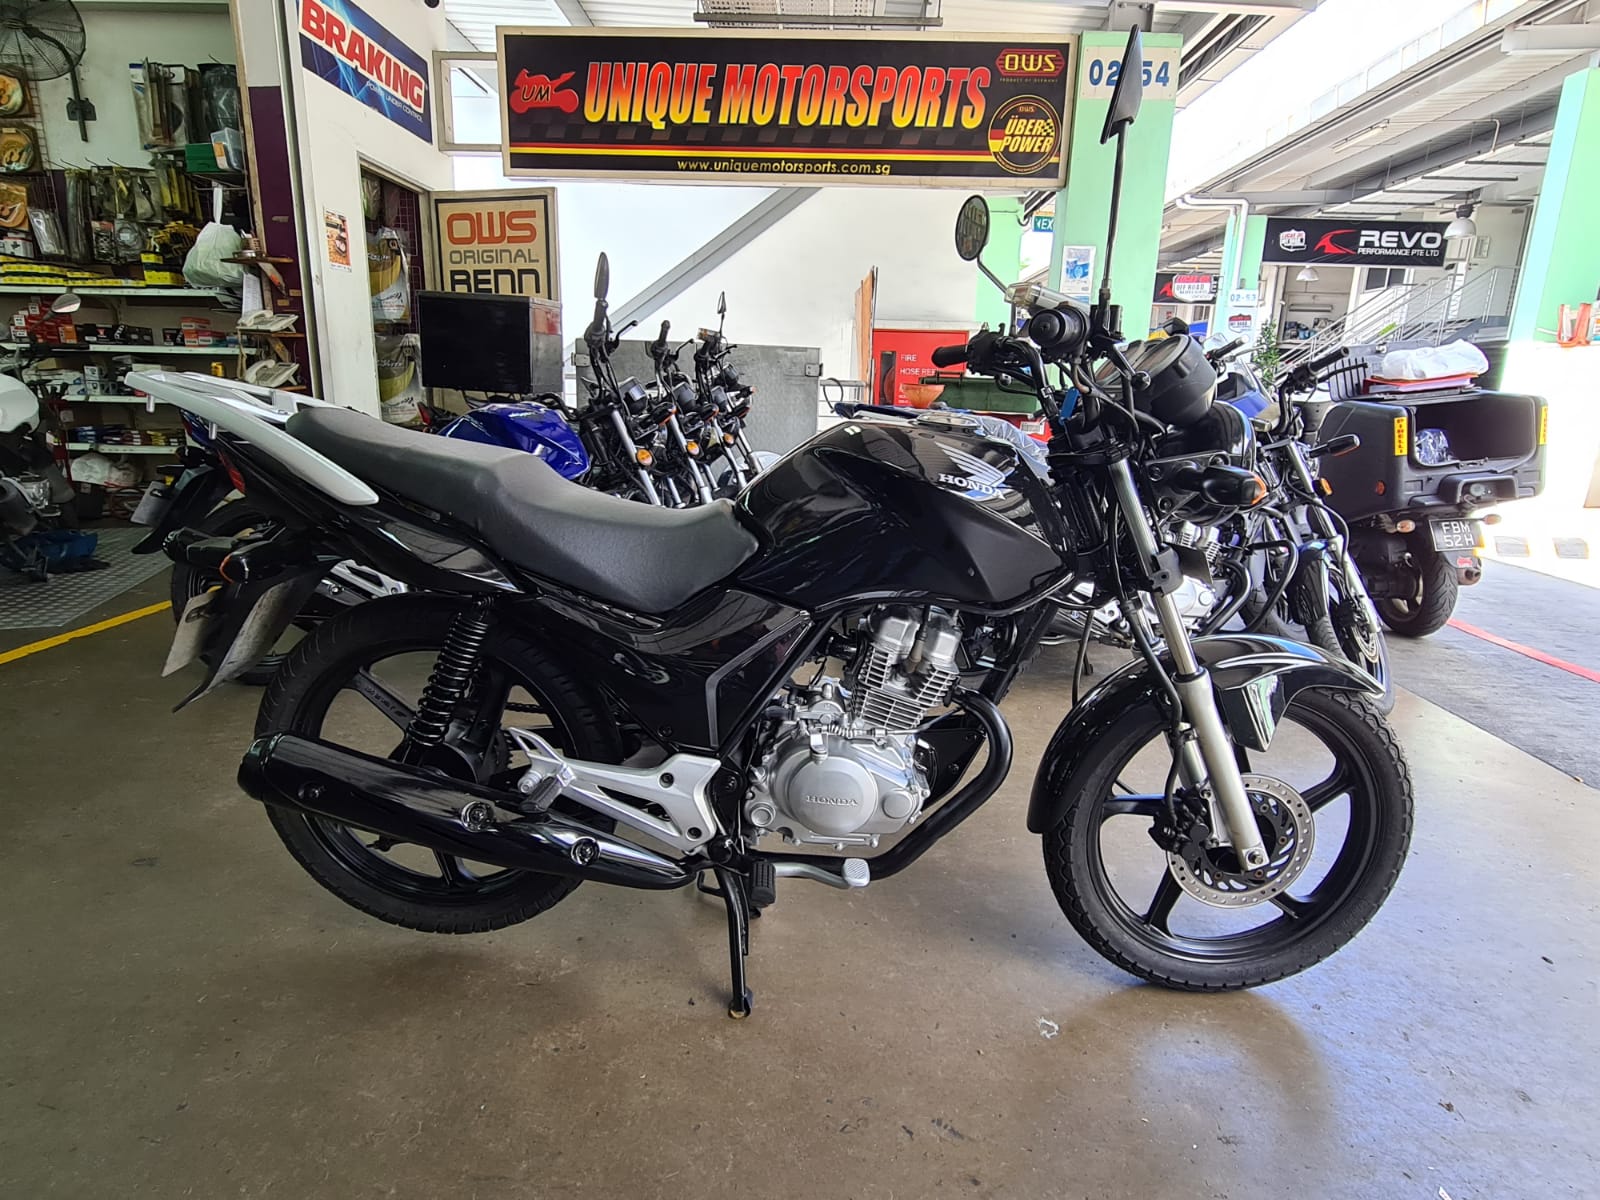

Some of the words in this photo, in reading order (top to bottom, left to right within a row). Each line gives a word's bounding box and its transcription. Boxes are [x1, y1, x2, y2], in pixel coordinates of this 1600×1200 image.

[301, 0, 424, 110] BRAKING
[1005, 53, 1057, 72] OWS
[1088, 58, 1170, 87] 0254
[520, 84, 552, 103] UM
[584, 61, 717, 130] UNIQUE
[718, 62, 992, 129] MOTORSPORTS
[1004, 115, 1043, 136] ÜBER
[1000, 135, 1053, 153] POWER
[677, 159, 891, 176] www.uniquemotorsports.com.sg
[446, 210, 537, 245] OWS
[1359, 229, 1442, 249] REVO
[449, 248, 540, 265] ORIGINAL
[1357, 248, 1410, 257] PERFORMANCE
[1425, 250, 1440, 258] LTD
[449, 268, 541, 294] RENN
[900, 353, 917, 362] FIRE
[900, 367, 920, 376] HOSE
[938, 473, 1006, 500] HONDA
[1441, 521, 1471, 534] FBM
[1444, 534, 1475, 547] 52H
[806, 794, 858, 807] HONDA
